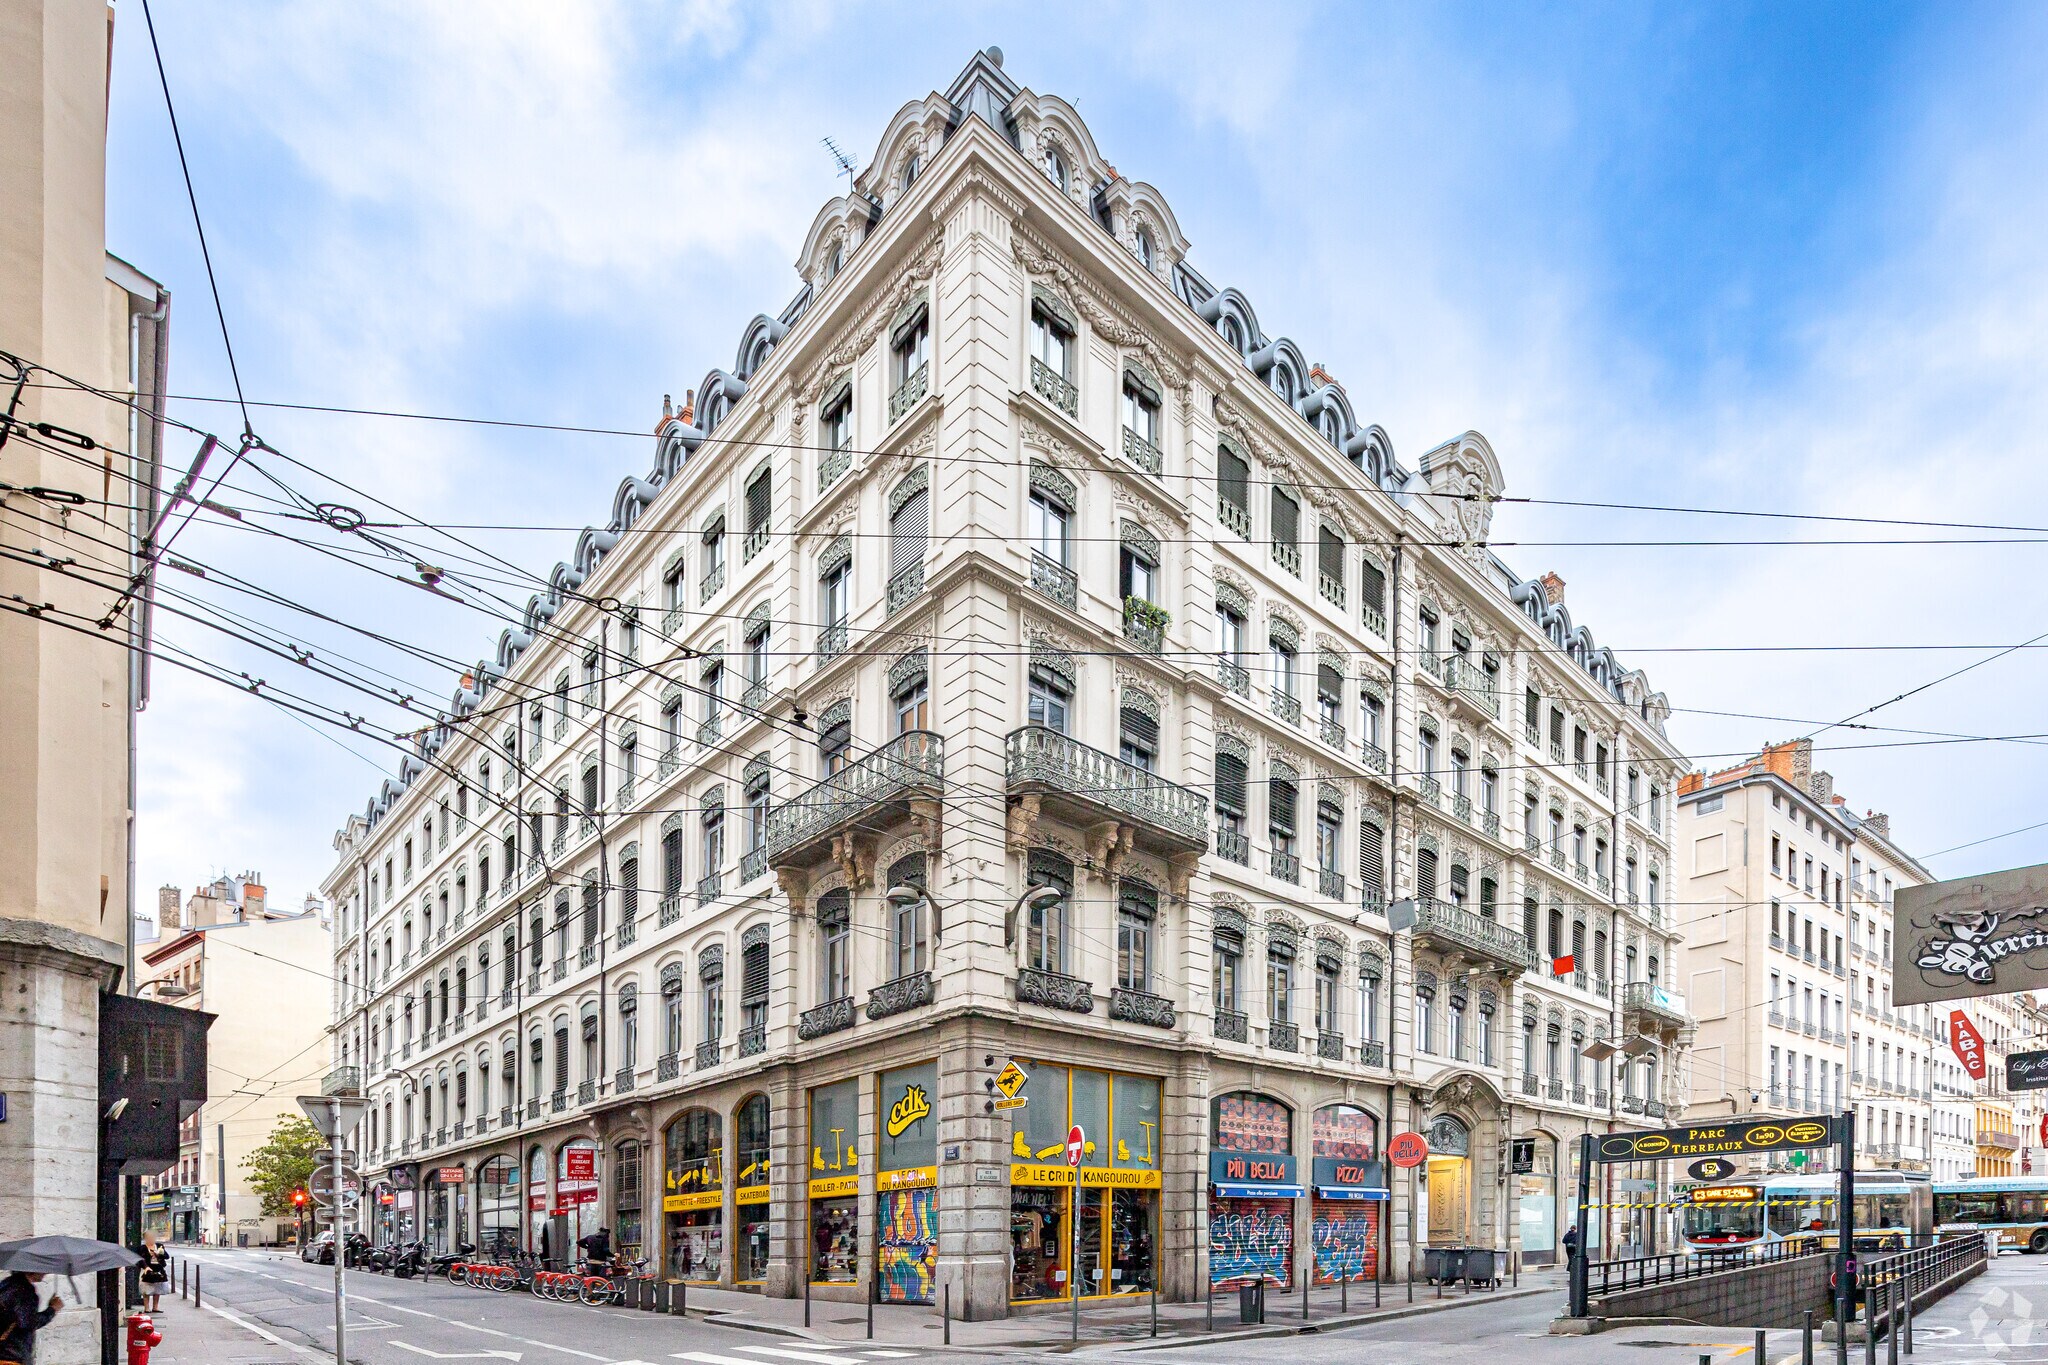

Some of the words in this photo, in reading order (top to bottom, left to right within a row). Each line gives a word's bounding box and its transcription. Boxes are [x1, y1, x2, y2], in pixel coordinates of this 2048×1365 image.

[1953, 1020, 1981, 1070] TABAC
[889, 1084, 930, 1126] cdk
[1689, 1129, 1725, 1140] PARC
[1394, 1149, 1420, 1158] BELLA
[1672, 1141, 1743, 1154] TERREAUX
[1033, 1169, 1045, 1181] LE
[1048, 1170, 1065, 1182] CRI
[1083, 1171, 1141, 1184] KANGOUROU
[1250, 1161, 1285, 1180] BELLA
[1336, 1164, 1365, 1183] PIZZA
[811, 1182, 835, 1193] ROLLER
[882, 1181, 892, 1191] DU
[893, 1177, 936, 1190] KANGOUROU
[666, 1198, 693, 1207] TROTTINETTE
[697, 1195, 721, 1205] FREESTYLE
[1694, 1190, 1706, 1200] C3
